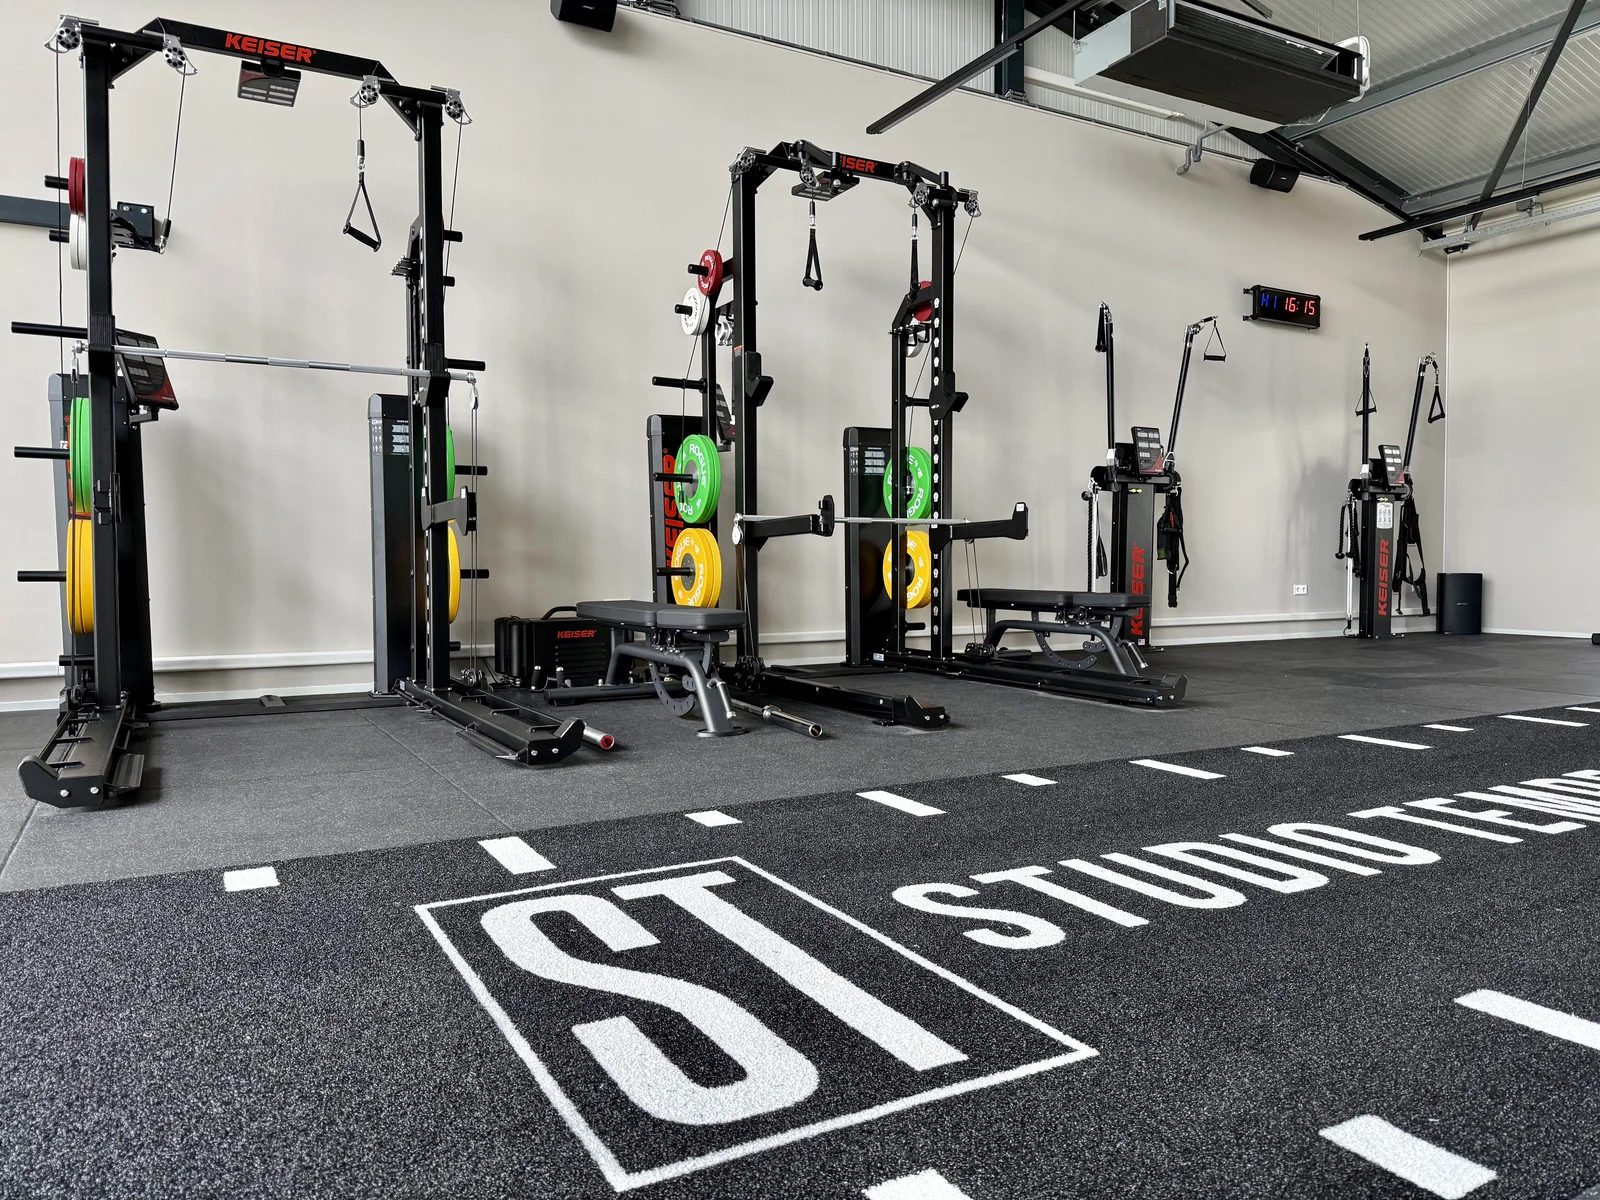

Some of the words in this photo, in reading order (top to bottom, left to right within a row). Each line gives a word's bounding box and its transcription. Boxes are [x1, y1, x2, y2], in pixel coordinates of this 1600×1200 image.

[225, 33, 312, 63] KEISER
[840, 155, 875, 173] ISER
[1285, 297, 1315, 316] 16:15
[1131, 546, 1145, 636] KSER
[1378, 539, 1389, 616] KEISER
[557, 630, 595, 639] KEISER
[892, 822, 1441, 949] STUDIO
[480, 870, 969, 1126] ST
